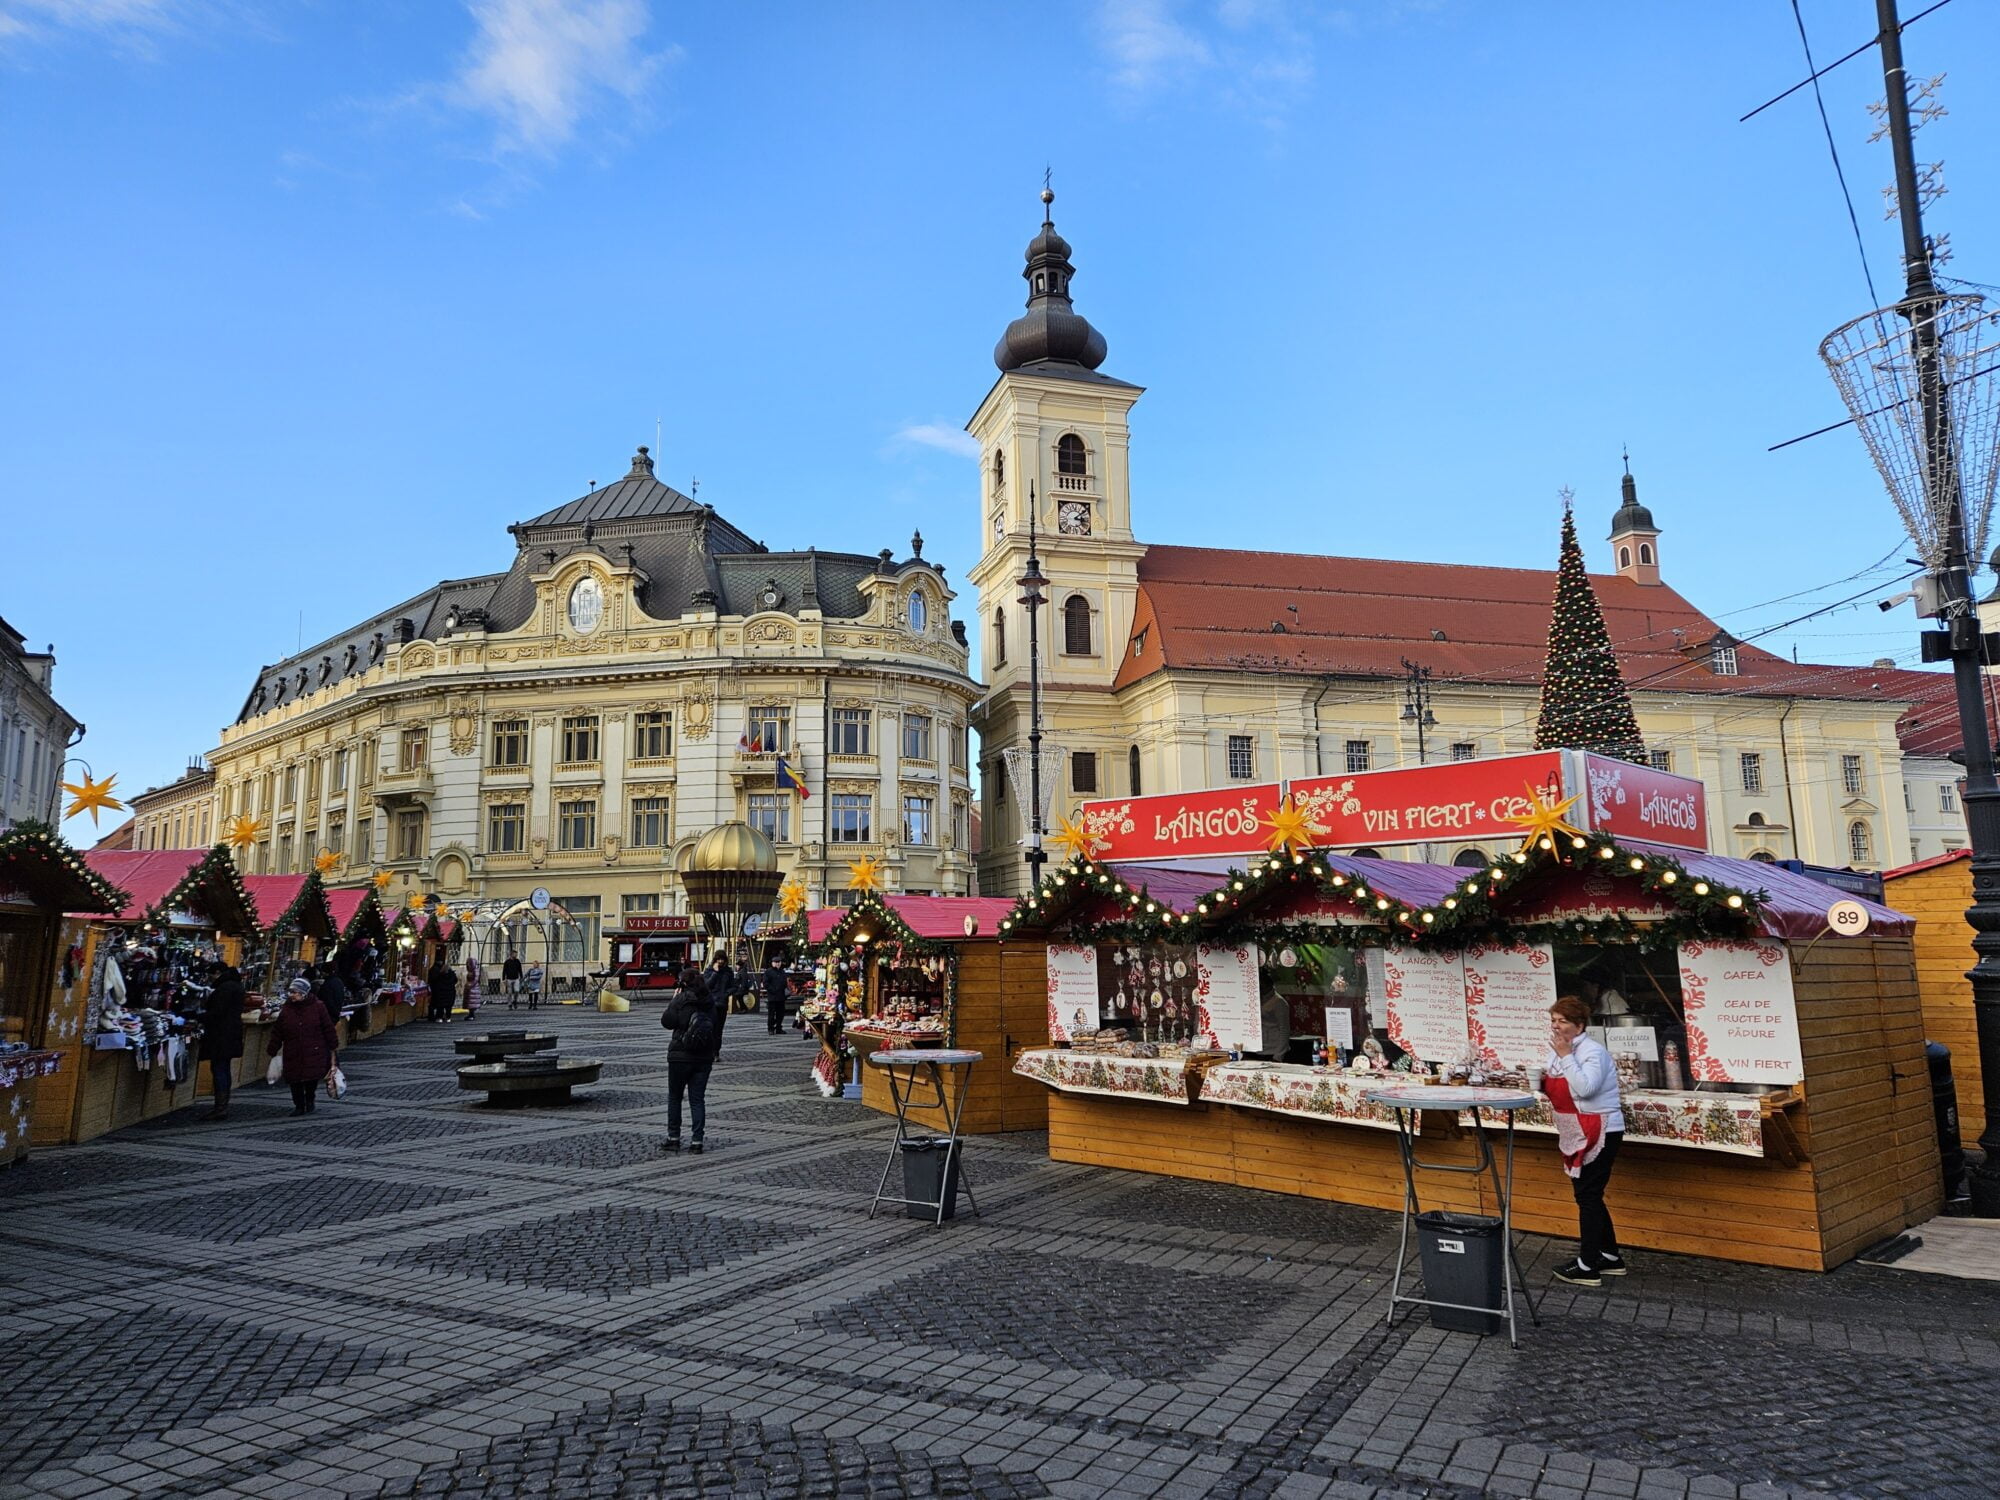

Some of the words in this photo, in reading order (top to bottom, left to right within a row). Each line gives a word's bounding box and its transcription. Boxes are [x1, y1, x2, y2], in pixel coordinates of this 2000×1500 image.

[1362, 809, 1400, 832] VIN
[1405, 801, 1475, 829] FIERT
[1837, 911, 1859, 924] 89
[628, 919, 649, 928] VIN
[654, 919, 688, 928] FIERT
[1723, 971, 1765, 980] CAFEA
[1724, 1000, 1750, 1008] CEAI
[1755, 1000, 1771, 1008] DE
[1717, 1014, 1761, 1023] FRUCTE
[1766, 1015, 1782, 1023] DE
[1727, 1027, 1775, 1038] PĂDURE
[1728, 1058, 1749, 1068] VIN
[1754, 1060, 1792, 1070] FIERT
